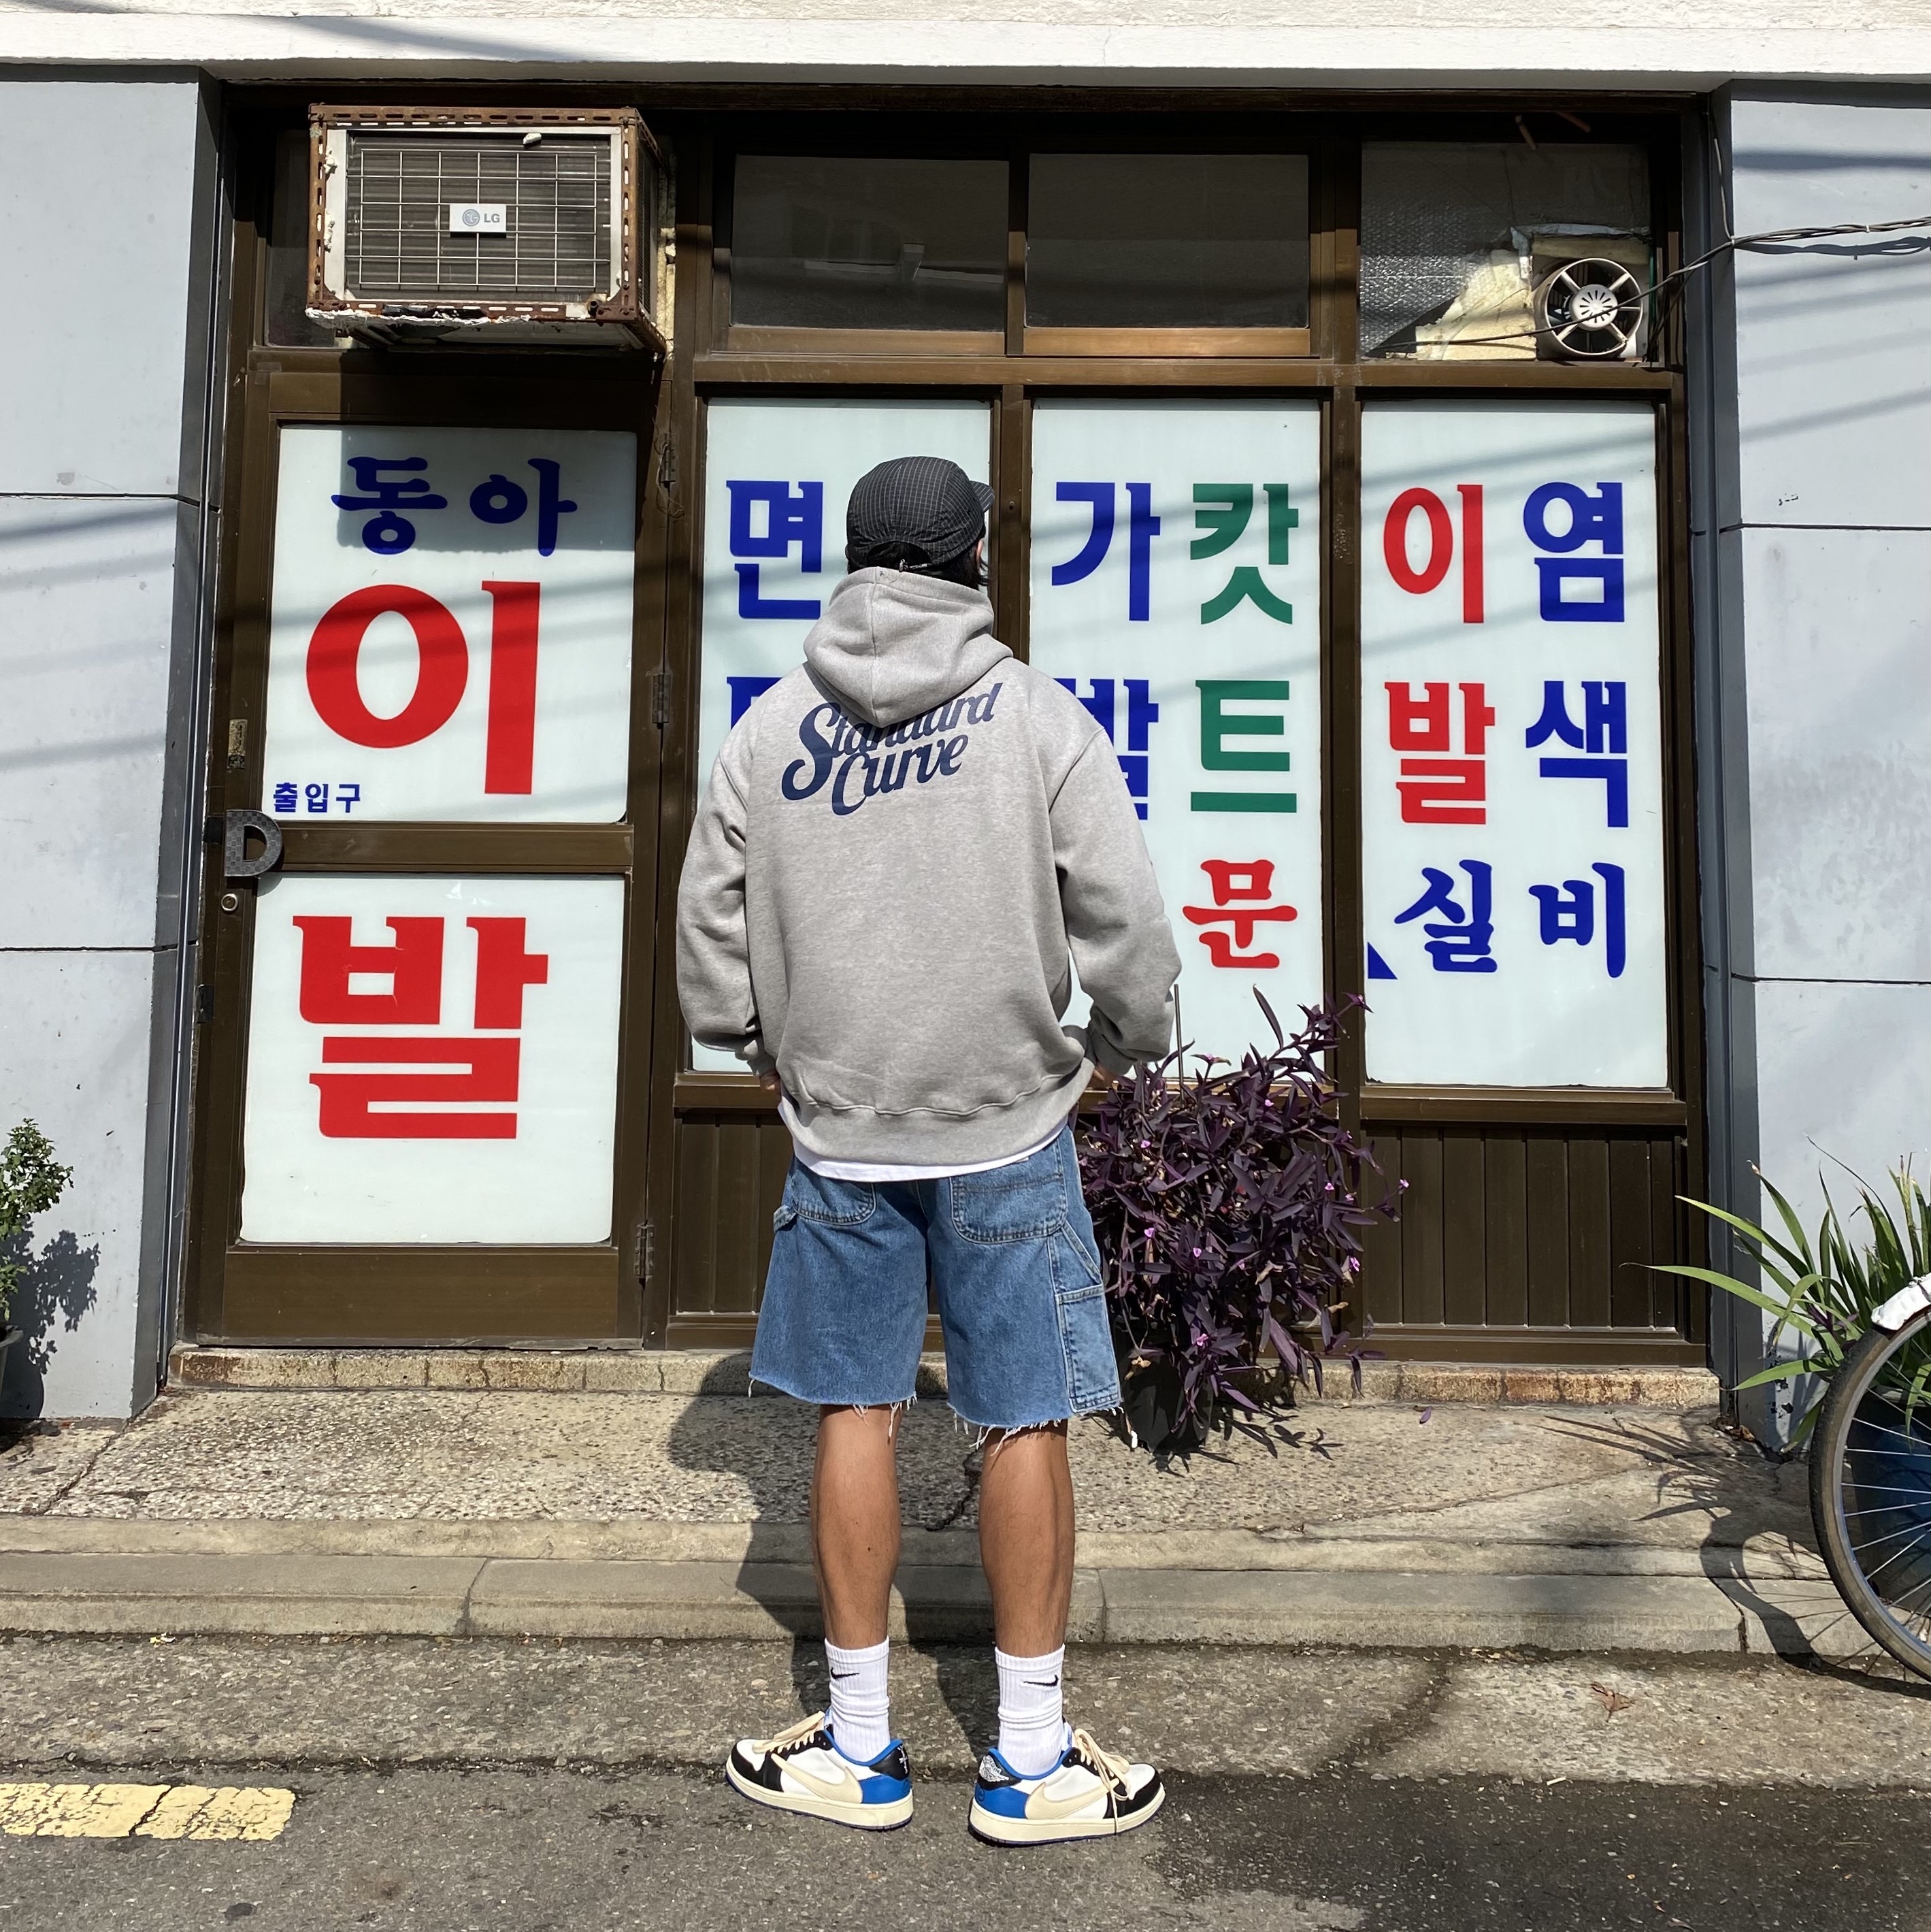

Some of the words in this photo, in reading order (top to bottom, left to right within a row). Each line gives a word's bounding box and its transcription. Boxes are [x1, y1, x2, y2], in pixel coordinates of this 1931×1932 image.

[484, 212, 501, 224] LG
[331, 457, 577, 557] 동아
[781, 682, 1004, 801] Standard
[831, 734, 969, 816] Curve
[273, 782, 361, 814] 출입구
